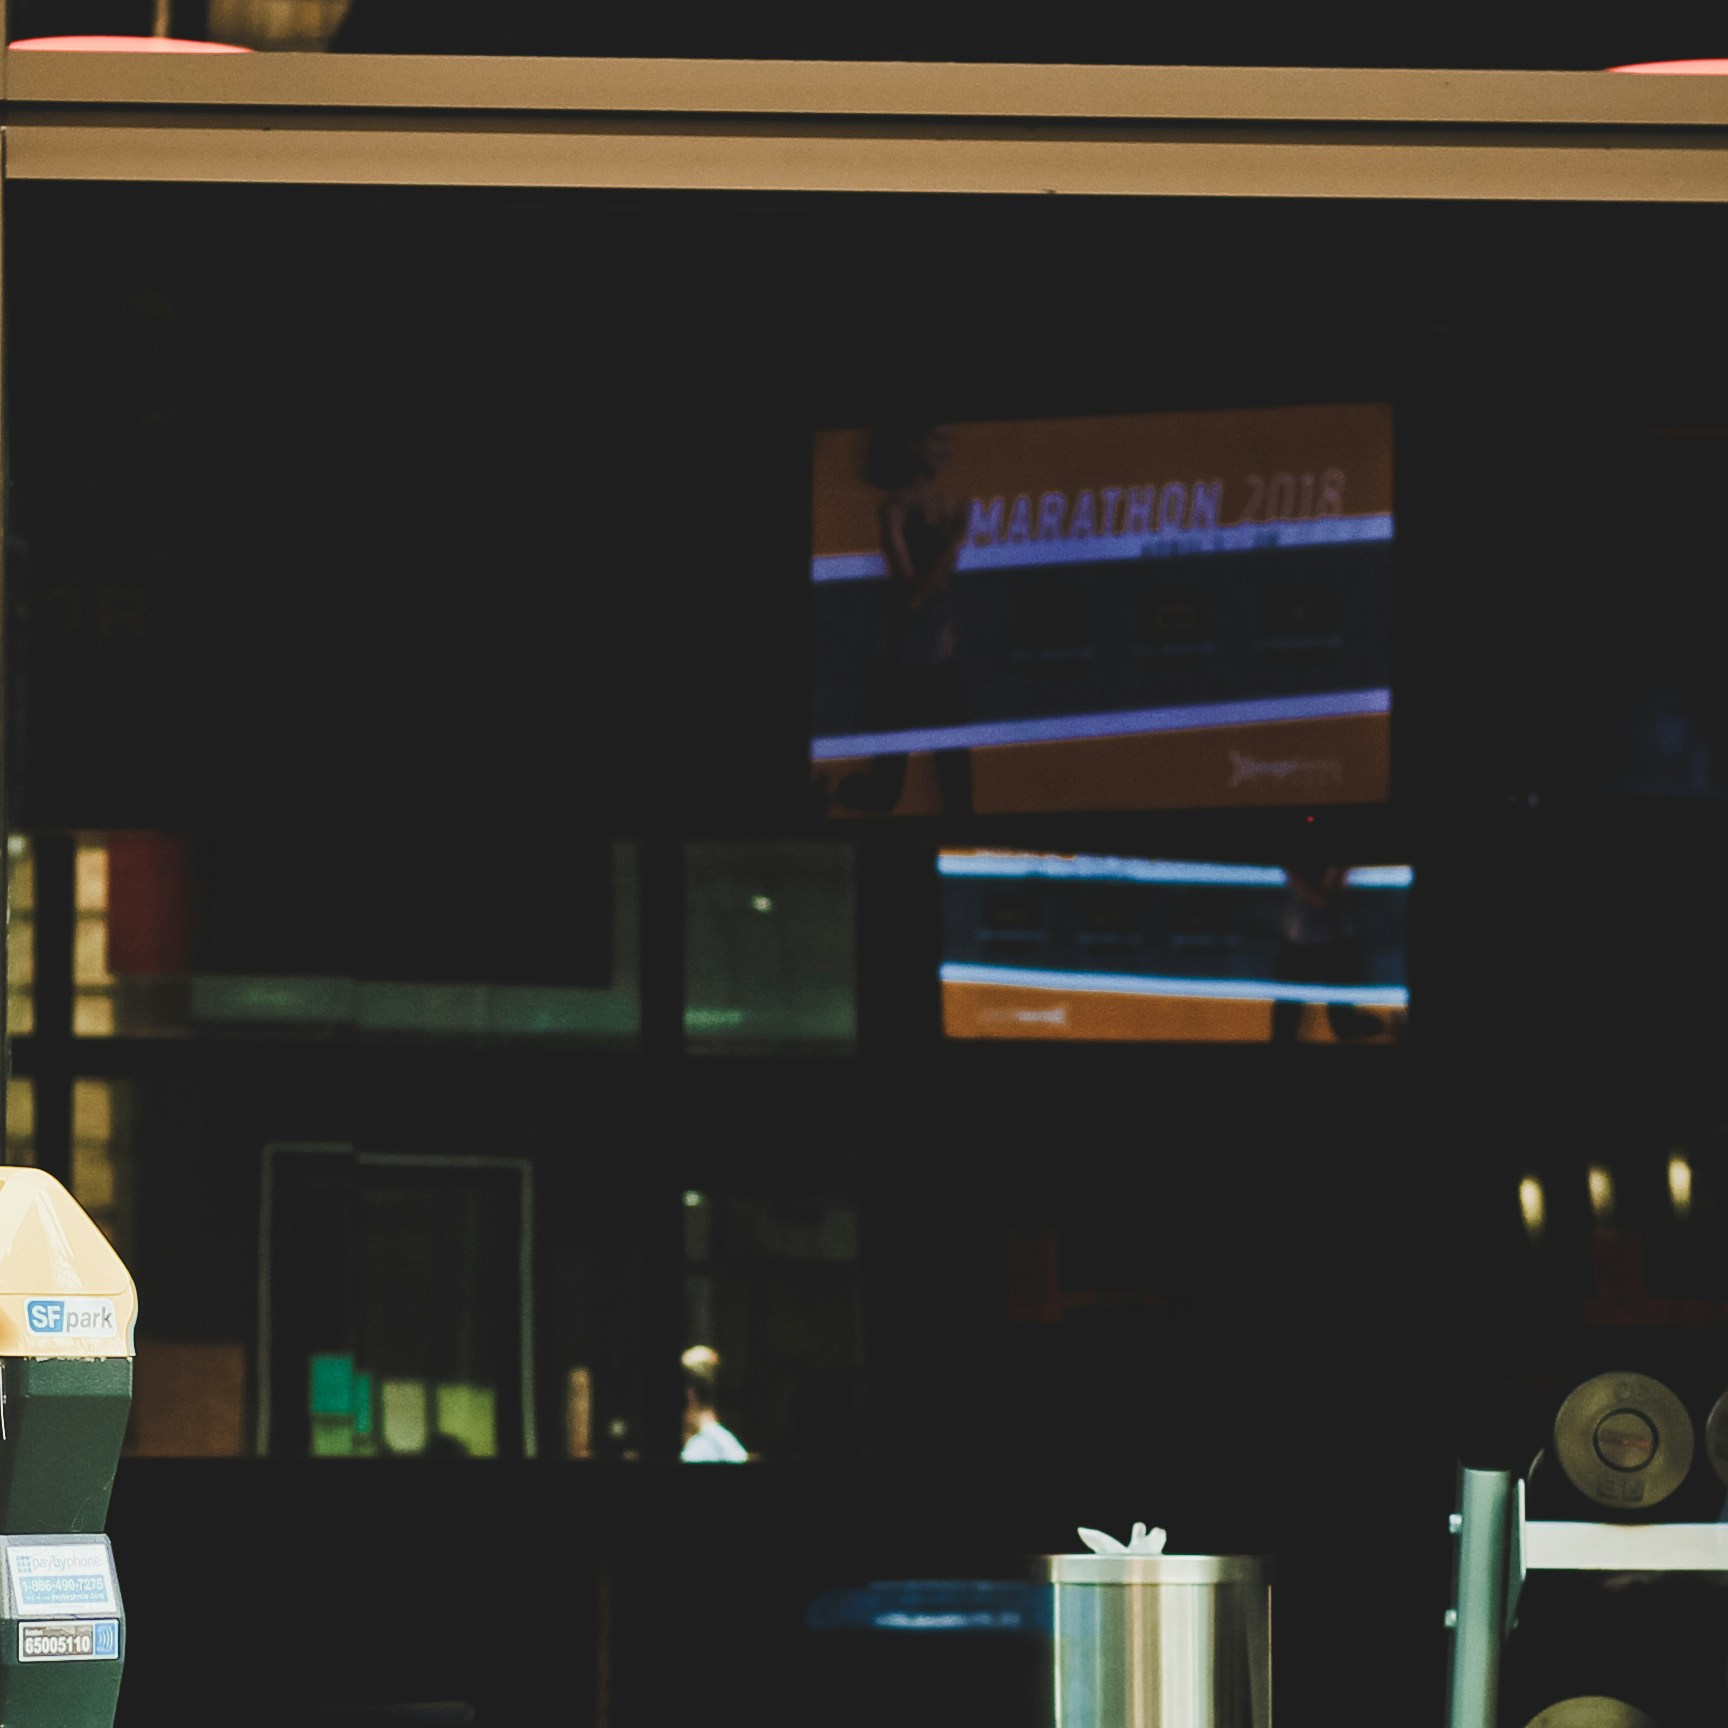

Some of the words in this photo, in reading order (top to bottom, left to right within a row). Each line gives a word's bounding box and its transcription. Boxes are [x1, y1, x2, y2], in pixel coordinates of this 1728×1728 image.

[966, 480, 1222, 546] MARATHON
[1236, 467, 1347, 523] 2018
[31, 1305, 61, 1328] SF
[66, 1306, 113, 1332] park
[32, 1555, 101, 1571] paybyphone
[25, 1636, 91, 1654] 65005110
